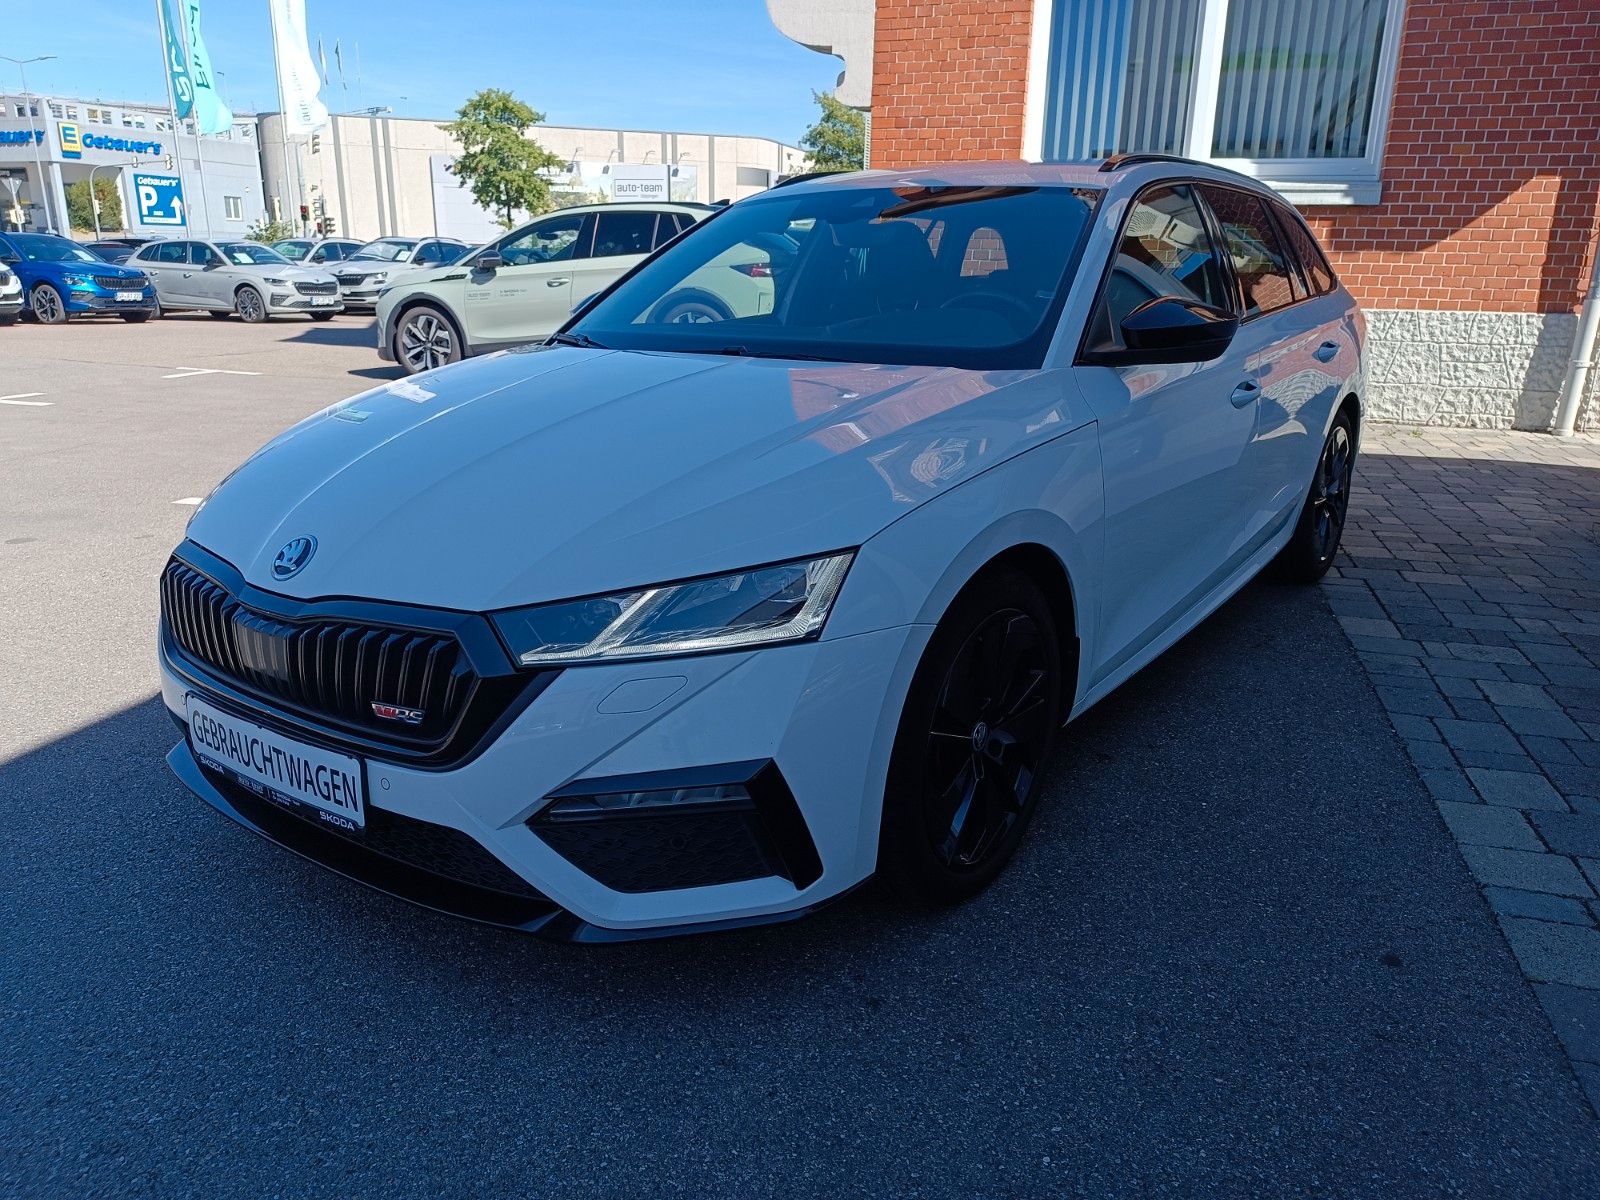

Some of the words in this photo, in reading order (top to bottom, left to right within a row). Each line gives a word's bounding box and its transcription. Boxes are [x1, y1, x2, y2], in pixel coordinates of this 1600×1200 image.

[82, 133, 162, 155] Gebauer's
[137, 176, 178, 187] Gebauer's
[617, 183, 663, 193] auto-team
[138, 185, 158, 216] P
[191, 709, 359, 813] GEBRAUCHTWAGEN
